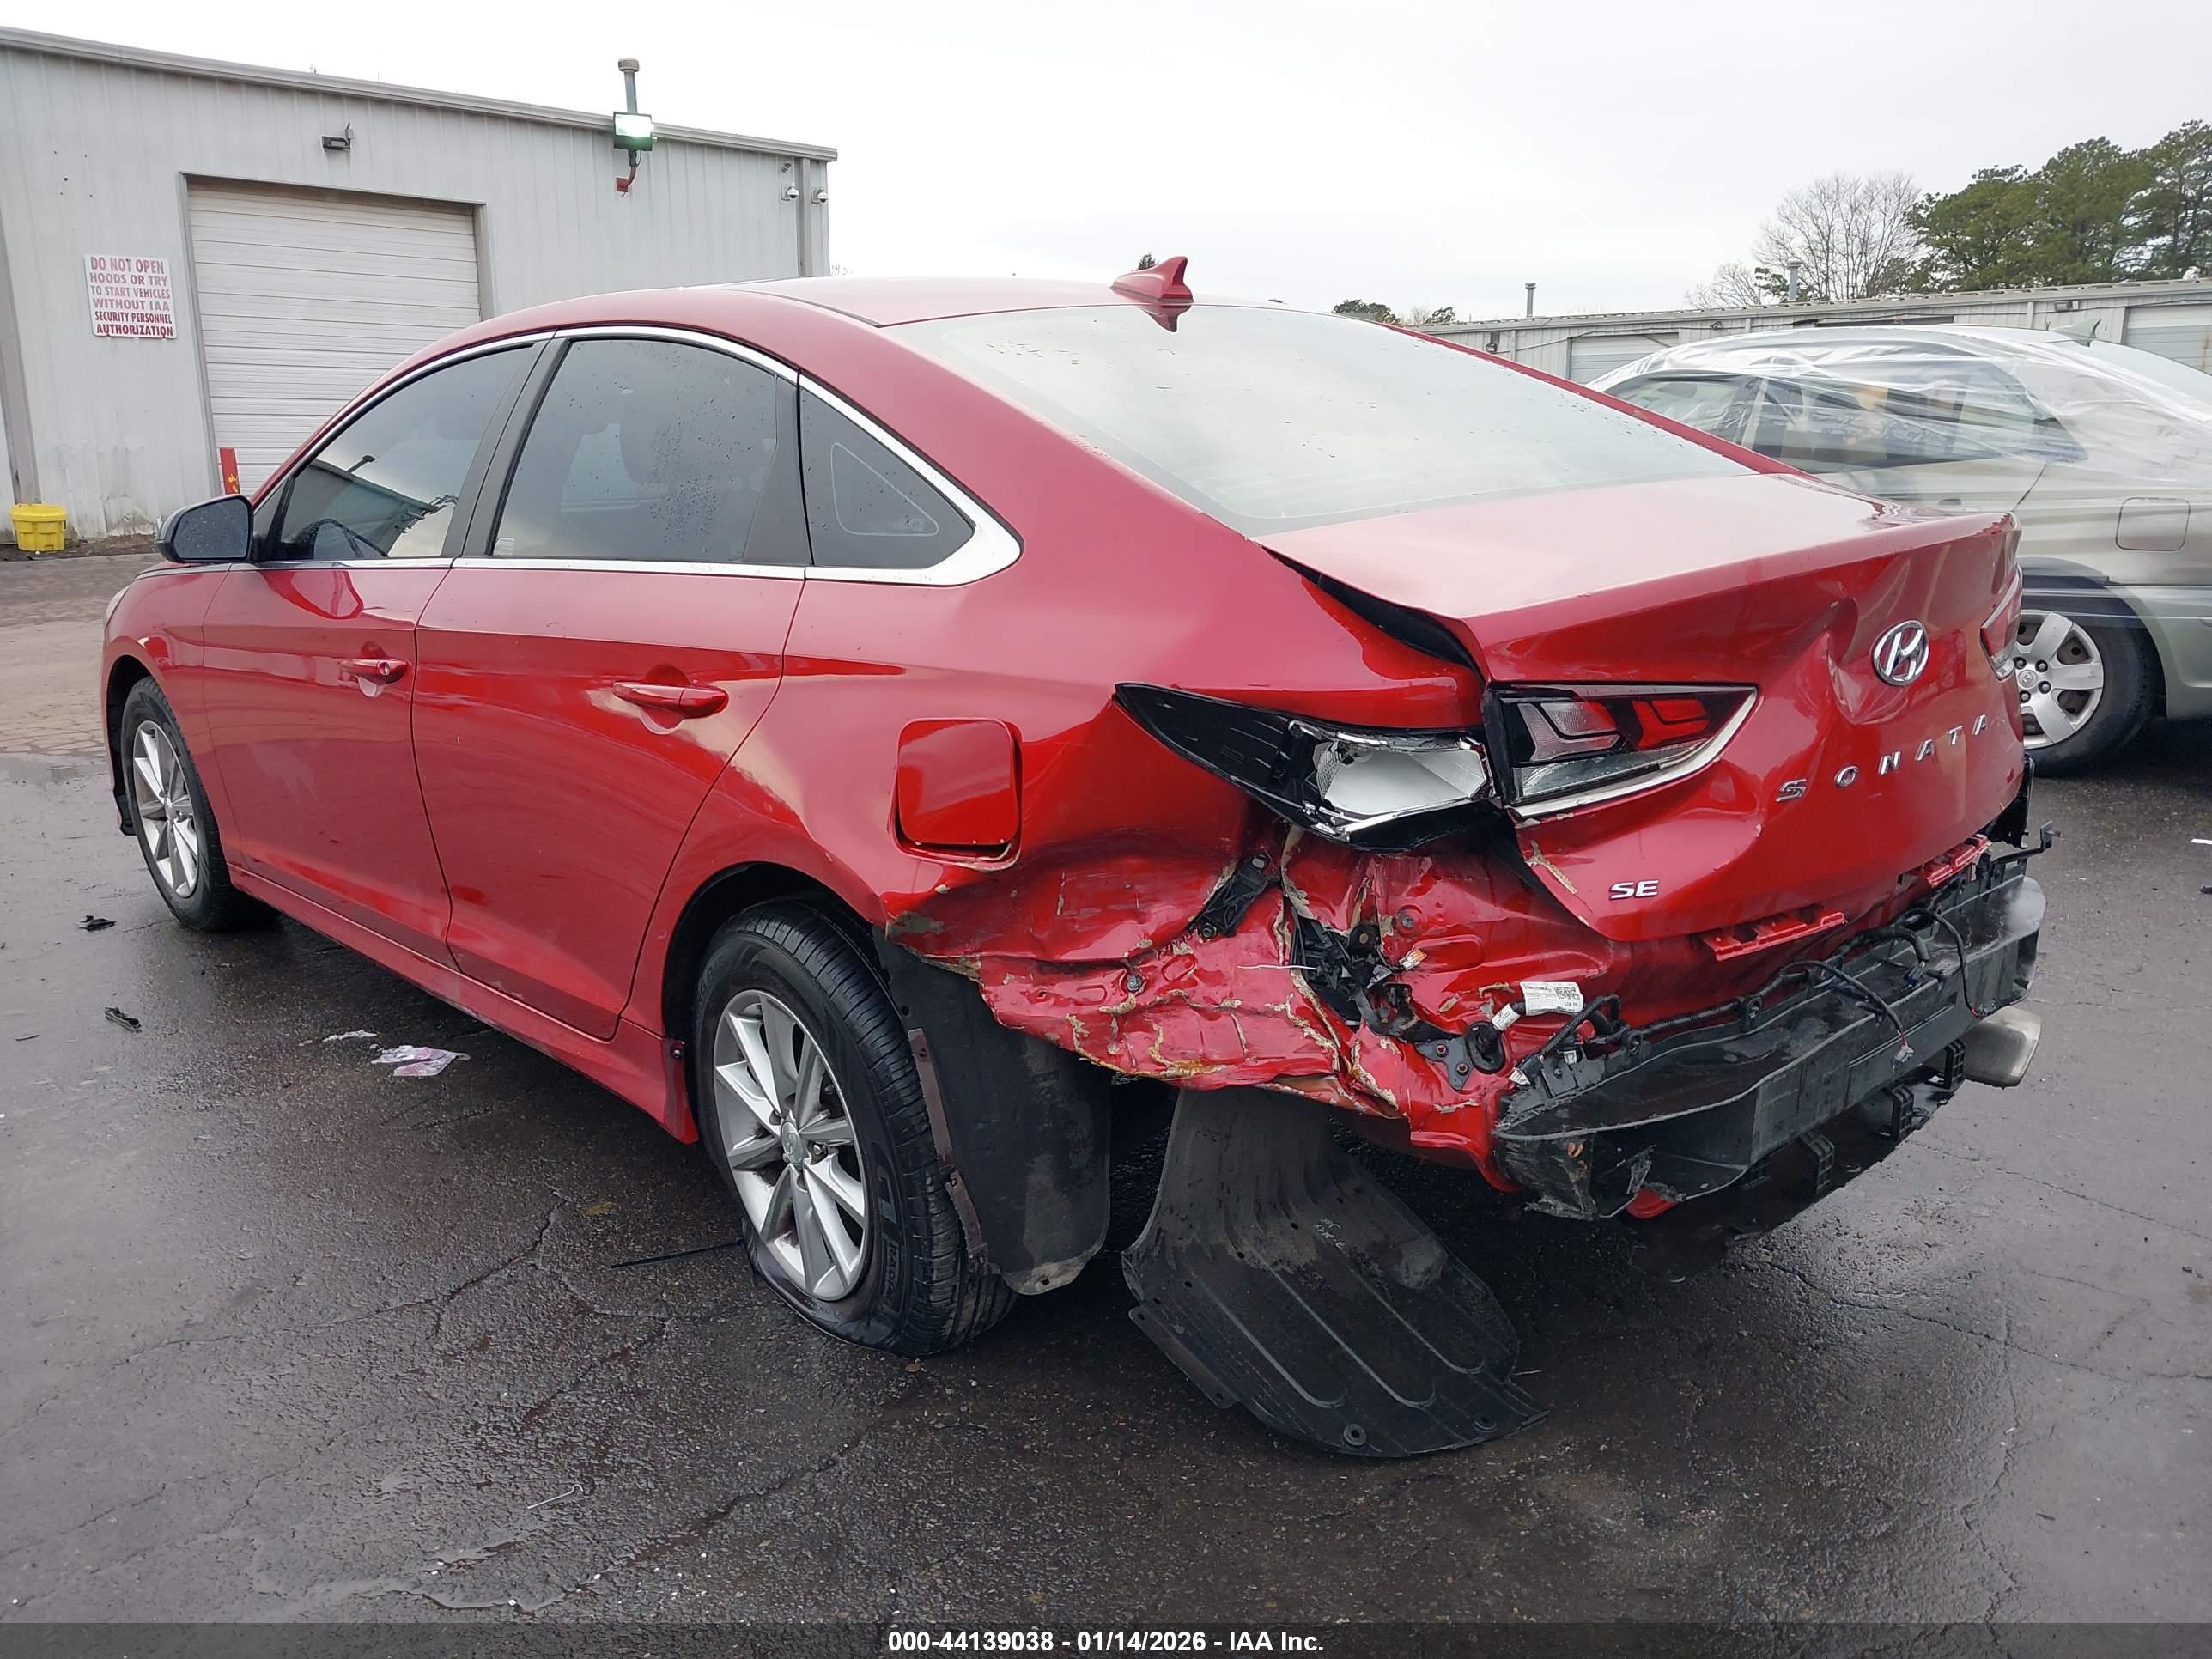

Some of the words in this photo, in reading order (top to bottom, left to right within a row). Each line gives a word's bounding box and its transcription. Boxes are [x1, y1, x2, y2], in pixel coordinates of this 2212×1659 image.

[90, 257, 106, 270] DO
[110, 258, 131, 272] NOT
[136, 259, 164, 274] OPEN
[89, 272, 126, 284] HOODS
[130, 275, 145, 285] OR
[148, 276, 167, 286] TRY
[90, 285, 102, 296] TO
[105, 286, 131, 297] START
[132, 288, 171, 299] VEHICLES
[93, 298, 146, 310] WITHOUT
[149, 301, 170, 311] IAA
[95, 311, 129, 322] SECURITY
[131, 313, 173, 324] PERSONNEL
[96, 324, 173, 337] AUTHORIZATION
[1775, 714, 1988, 803] SONATA
[1608, 879, 1660, 901] SE
